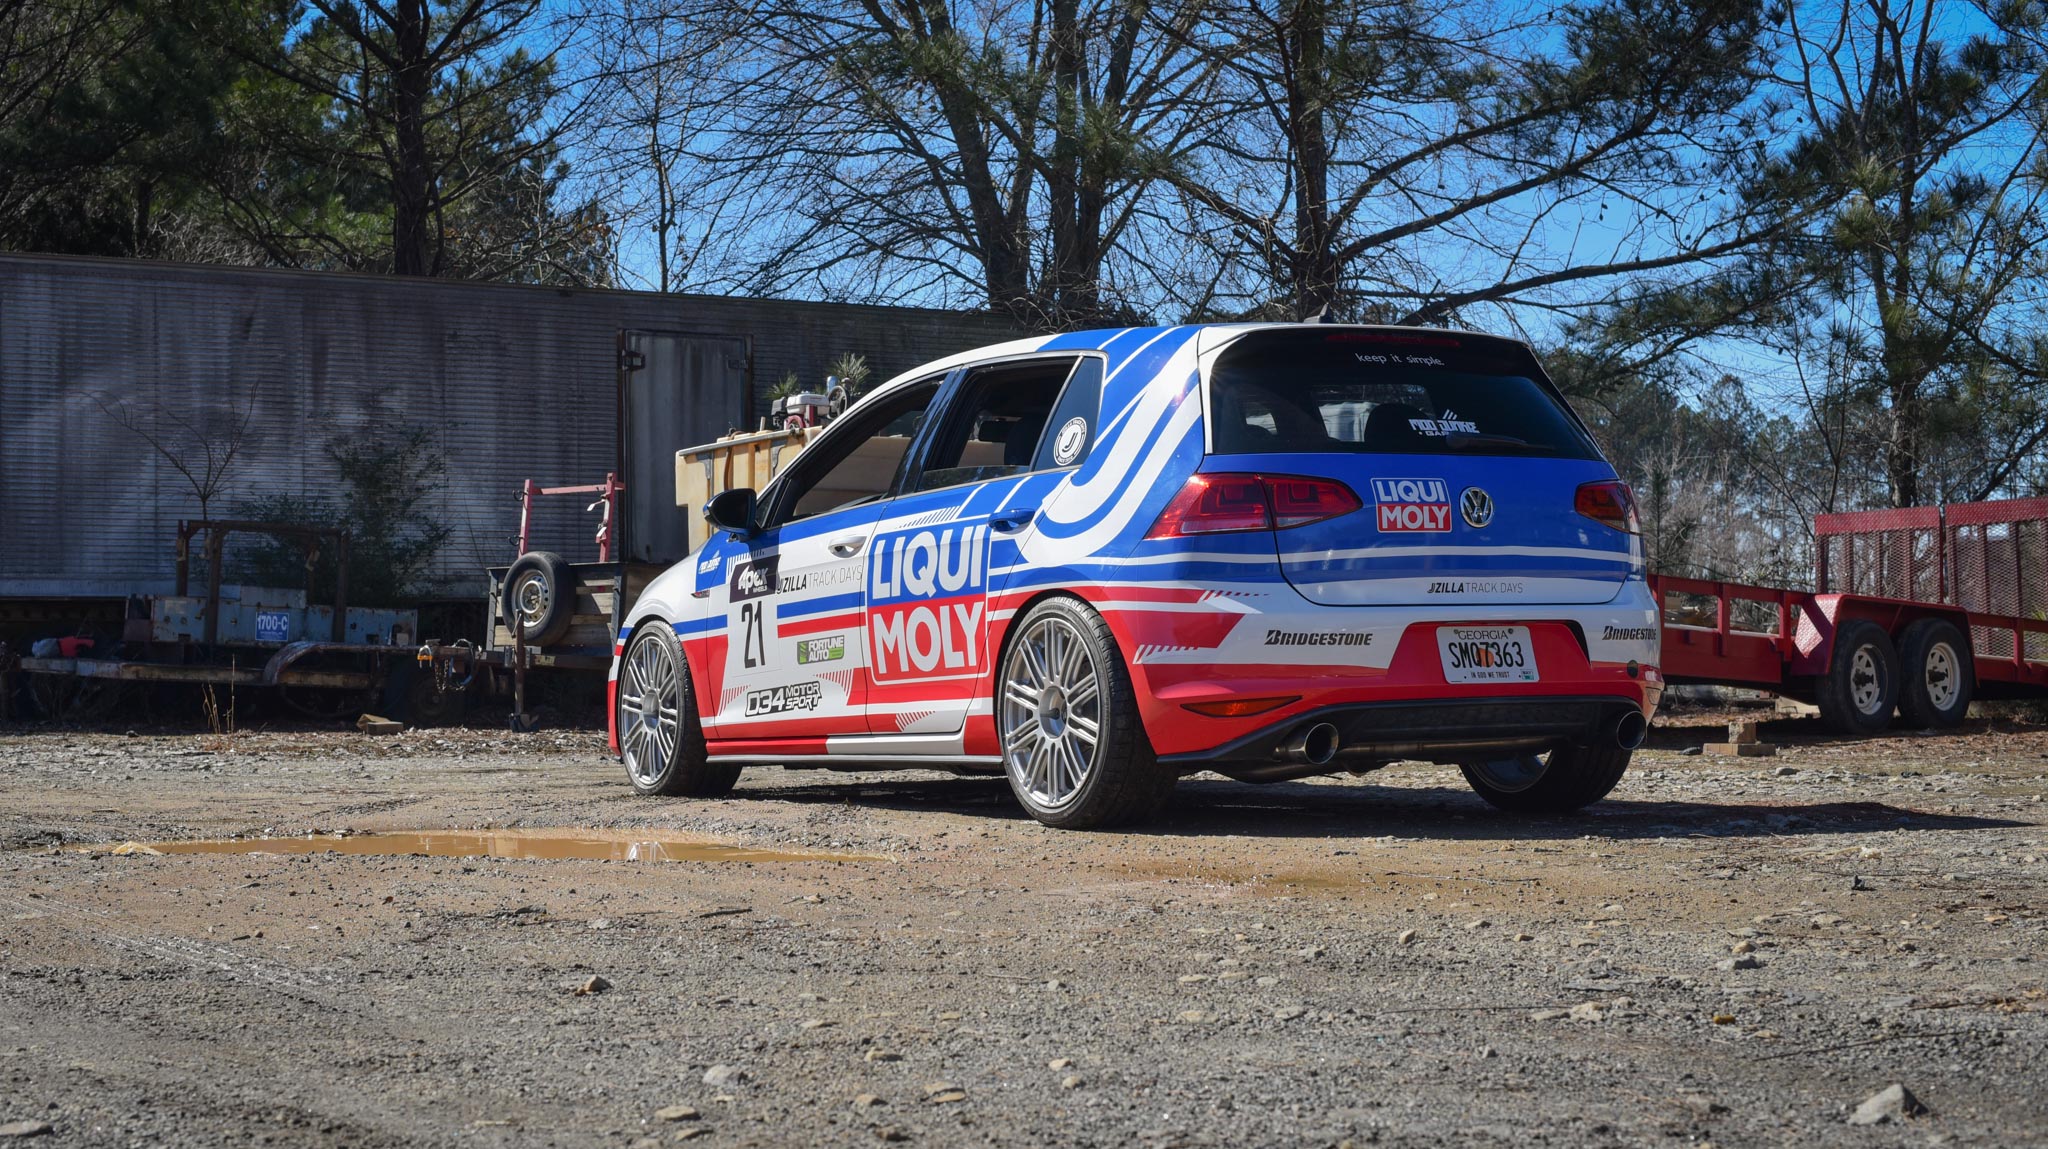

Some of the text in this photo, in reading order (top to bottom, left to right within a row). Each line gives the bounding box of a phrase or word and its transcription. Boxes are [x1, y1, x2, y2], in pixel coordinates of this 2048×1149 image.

[1355, 353, 1387, 364] keep
[1390, 354, 1402, 362] it
[1376, 481, 1446, 503] LIQUI
[1381, 505, 1449, 529] MOLY
[872, 524, 986, 599] LIQUI
[808, 569, 836, 588] TRACK
[840, 565, 864, 583] DAYS
[1465, 582, 1498, 593] TRACK
[1501, 582, 1524, 593] DAYS
[741, 601, 765, 668] 21
[873, 602, 985, 674] MOLY
[1264, 630, 1373, 646] BRIDGESTONE
[1458, 630, 1508, 640] GEORGIA
[808, 637, 844, 652] FORTUNE
[808, 650, 829, 662] AUTO
[1448, 642, 1524, 668] SMQ7363
[785, 682, 820, 698] MOTOR
[785, 695, 821, 711] SPORT
